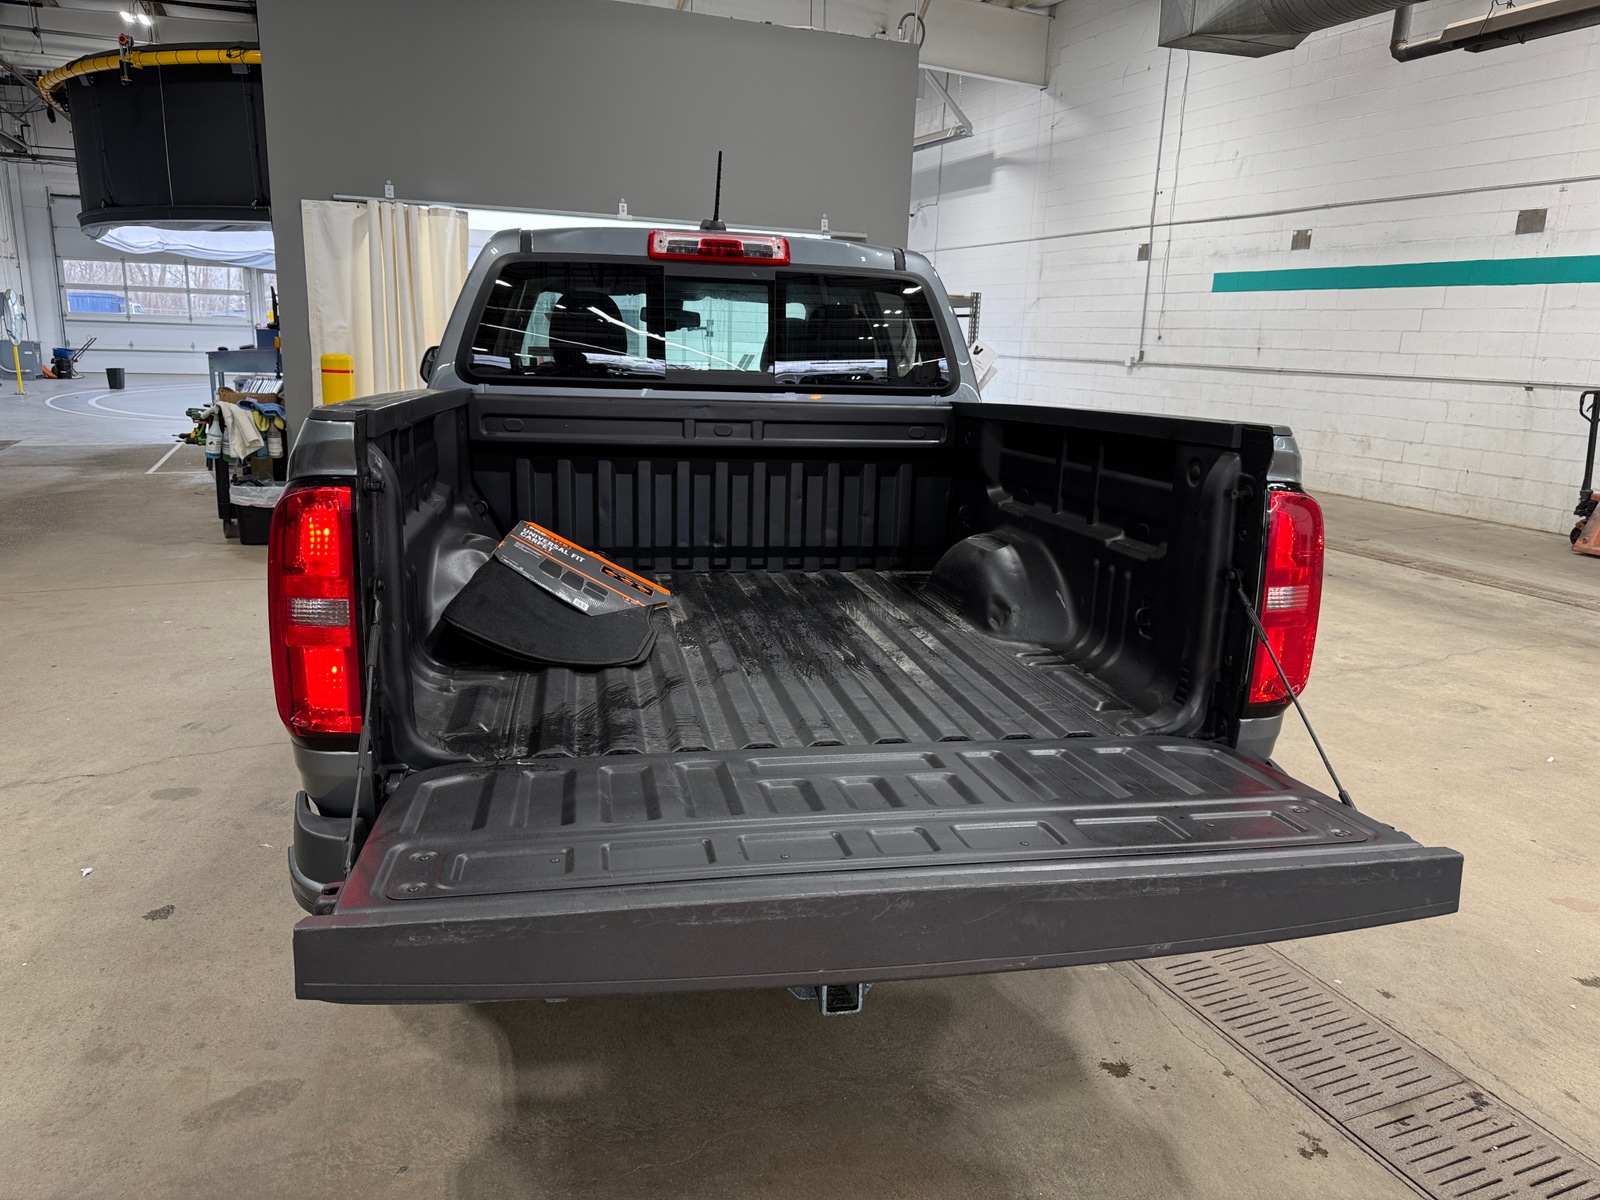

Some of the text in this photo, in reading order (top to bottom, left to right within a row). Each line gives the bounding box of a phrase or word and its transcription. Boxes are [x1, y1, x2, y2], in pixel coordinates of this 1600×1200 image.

[520, 532, 554, 552] CARPET
[523, 528, 569, 556] UNIVERSAL
[571, 553, 585, 563] FIT
